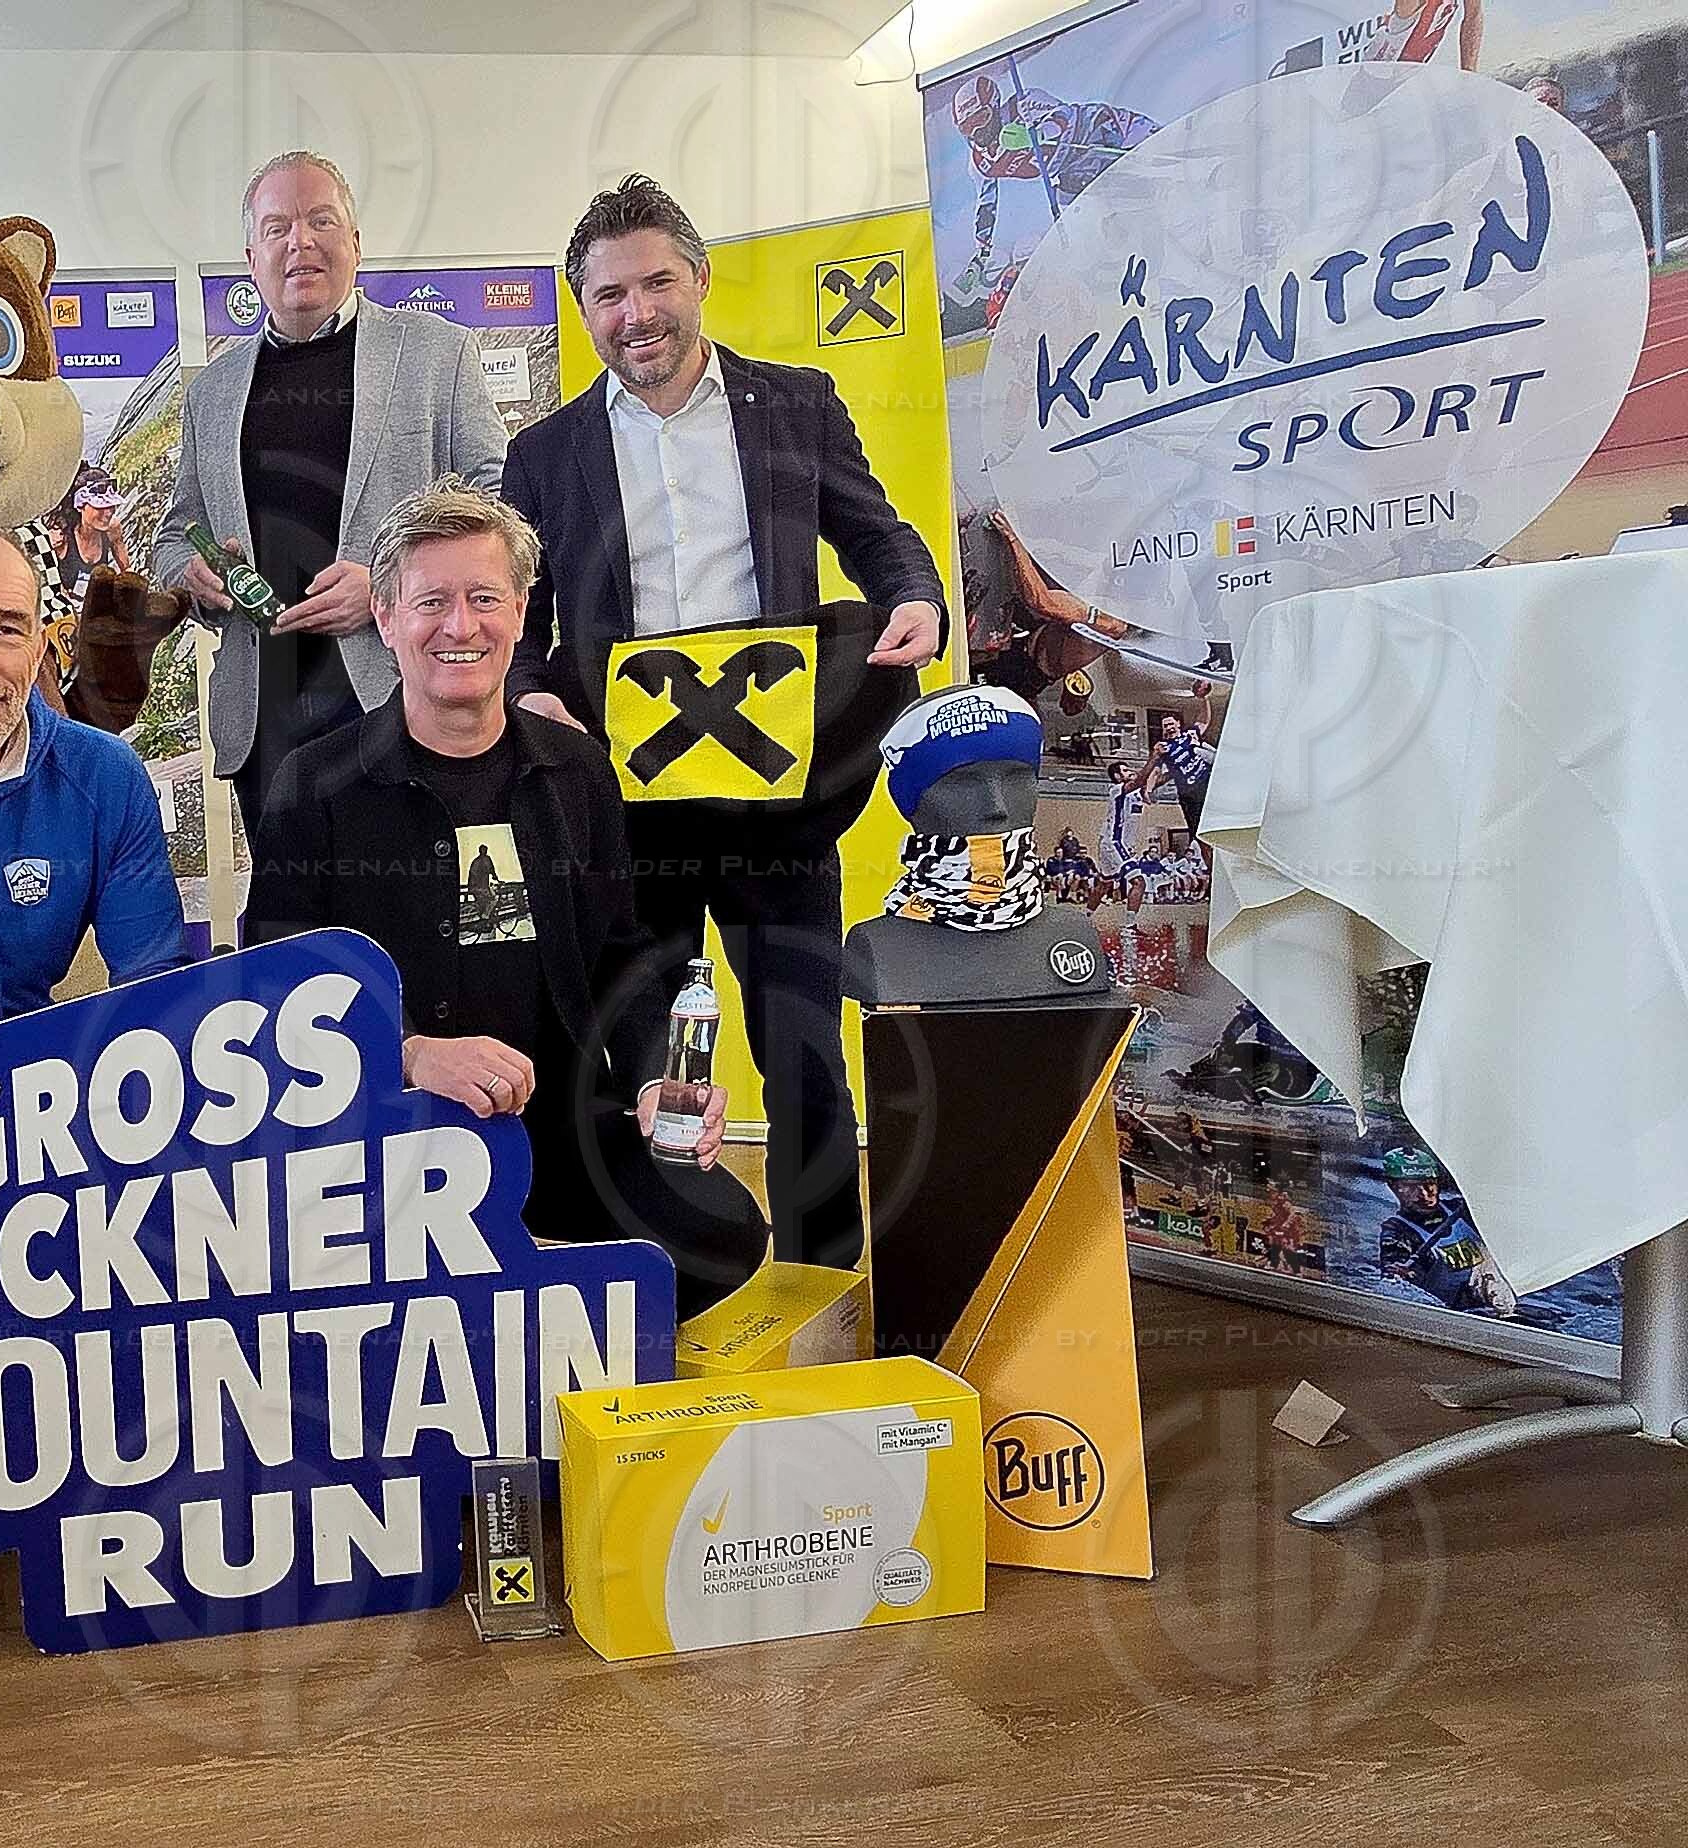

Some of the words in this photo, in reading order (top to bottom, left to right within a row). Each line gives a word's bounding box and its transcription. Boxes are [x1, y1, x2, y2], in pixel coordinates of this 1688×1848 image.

[486, 284, 530, 296] KLEINE
[1036, 136, 1552, 430] KÄRNTEN
[395, 301, 456, 312] GASTEINER
[486, 295, 531, 307] ZEITUNG
[63, 355, 121, 366] SUZUKI
[1232, 370, 1546, 472] SPORT
[1112, 530, 1199, 568] LAND
[1274, 491, 1457, 545] KÄRNTEN
[1216, 569, 1273, 591] Sport
[930, 710, 1009, 740] MOUNTAIN
[950, 723, 988, 738] RUN
[615, 1400, 763, 1425] ARTHROBENE
[881, 1428, 899, 1439] mit
[899, 1424, 936, 1438] Vitamin
[881, 1438, 899, 1450] mit
[616, 1454, 629, 1465] 15
[630, 1449, 666, 1464] STICKS
[823, 1502, 873, 1524] Sport
[59, 1477, 422, 1617] RUN
[703, 1525, 874, 1567] ARTHROBENE
[703, 1569, 726, 1583] DER
[728, 1556, 831, 1579] MAGNESIUMSTICK
[832, 1552, 855, 1566] FÜR
[703, 1577, 758, 1595] KNORPEL
[761, 1575, 785, 1589] UND
